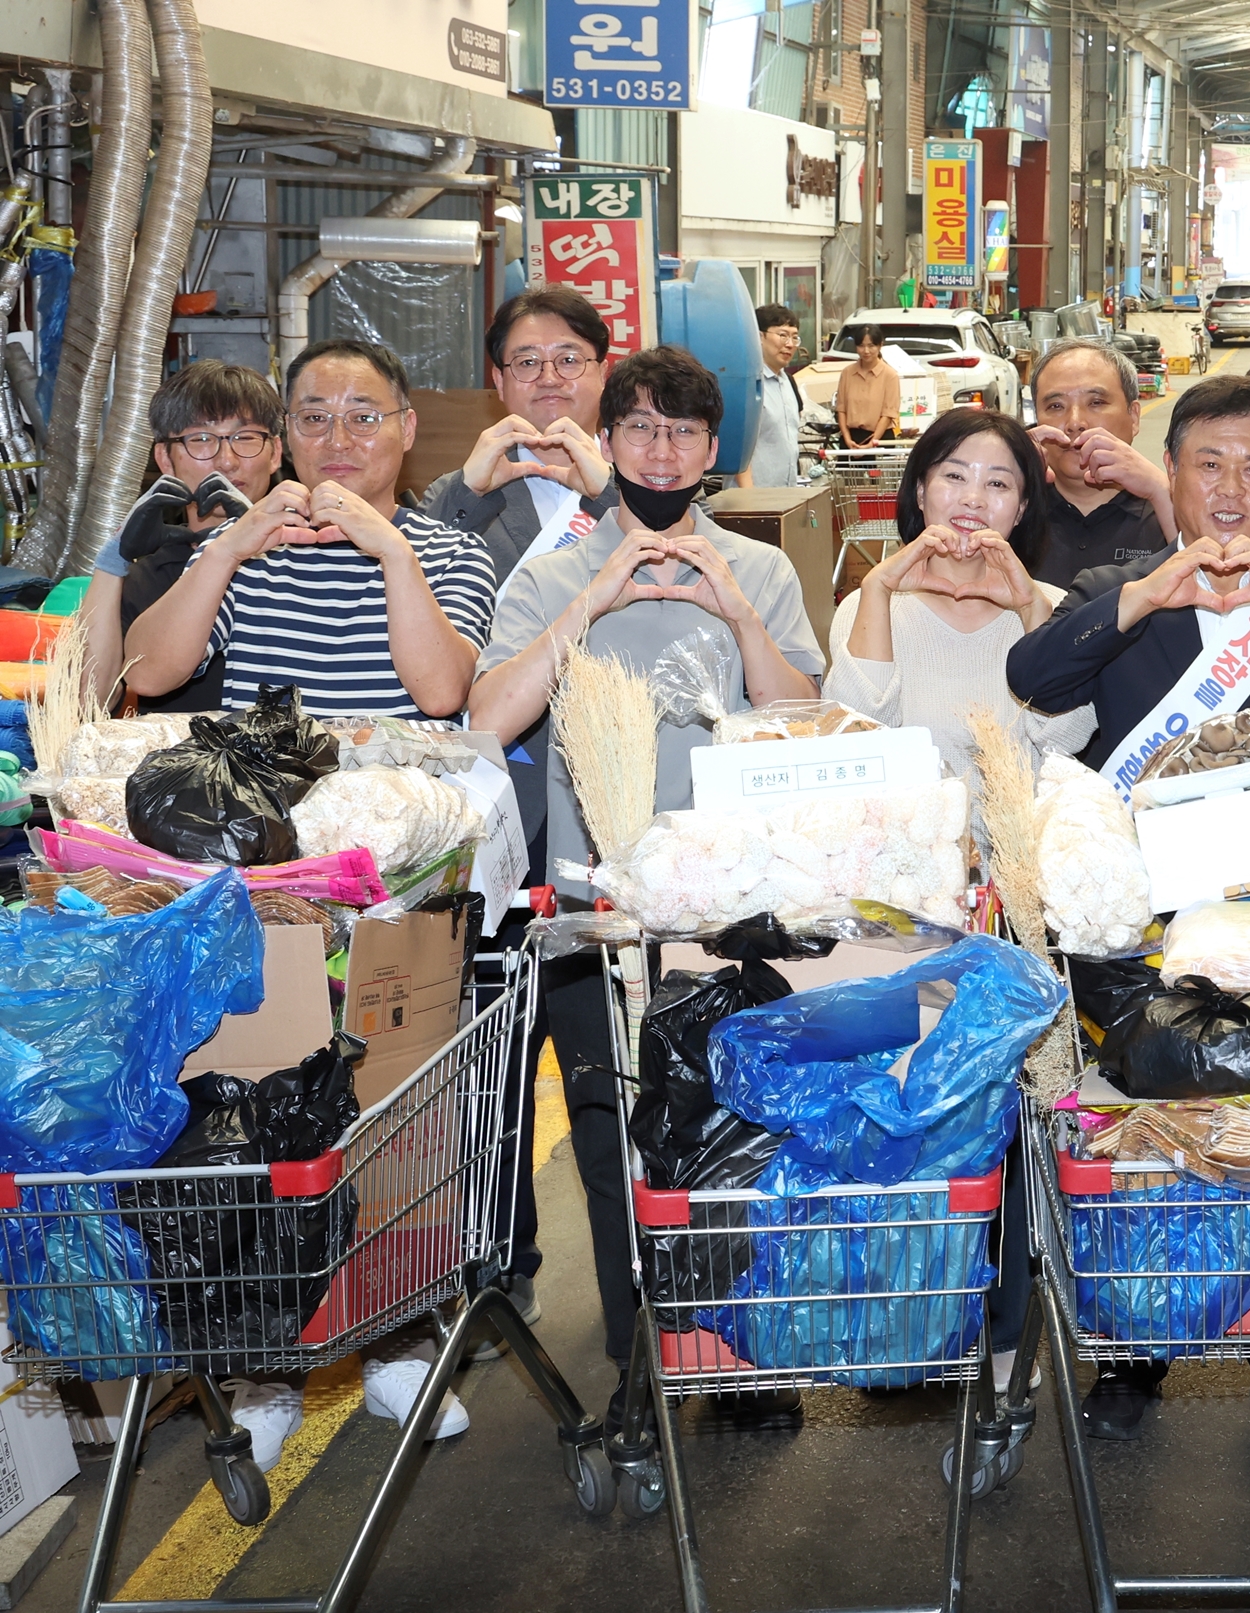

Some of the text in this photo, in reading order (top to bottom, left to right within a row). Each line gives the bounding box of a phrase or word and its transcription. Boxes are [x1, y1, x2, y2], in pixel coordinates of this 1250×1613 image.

[552, 77, 682, 101] 531-0352
[538, 181, 636, 217] 내장
[932, 166, 969, 260] 미용실
[928, 266, 974, 275] 532-4766
[928, 275, 973, 286] 010-4654-4766
[751, 772, 789, 788] 생산자
